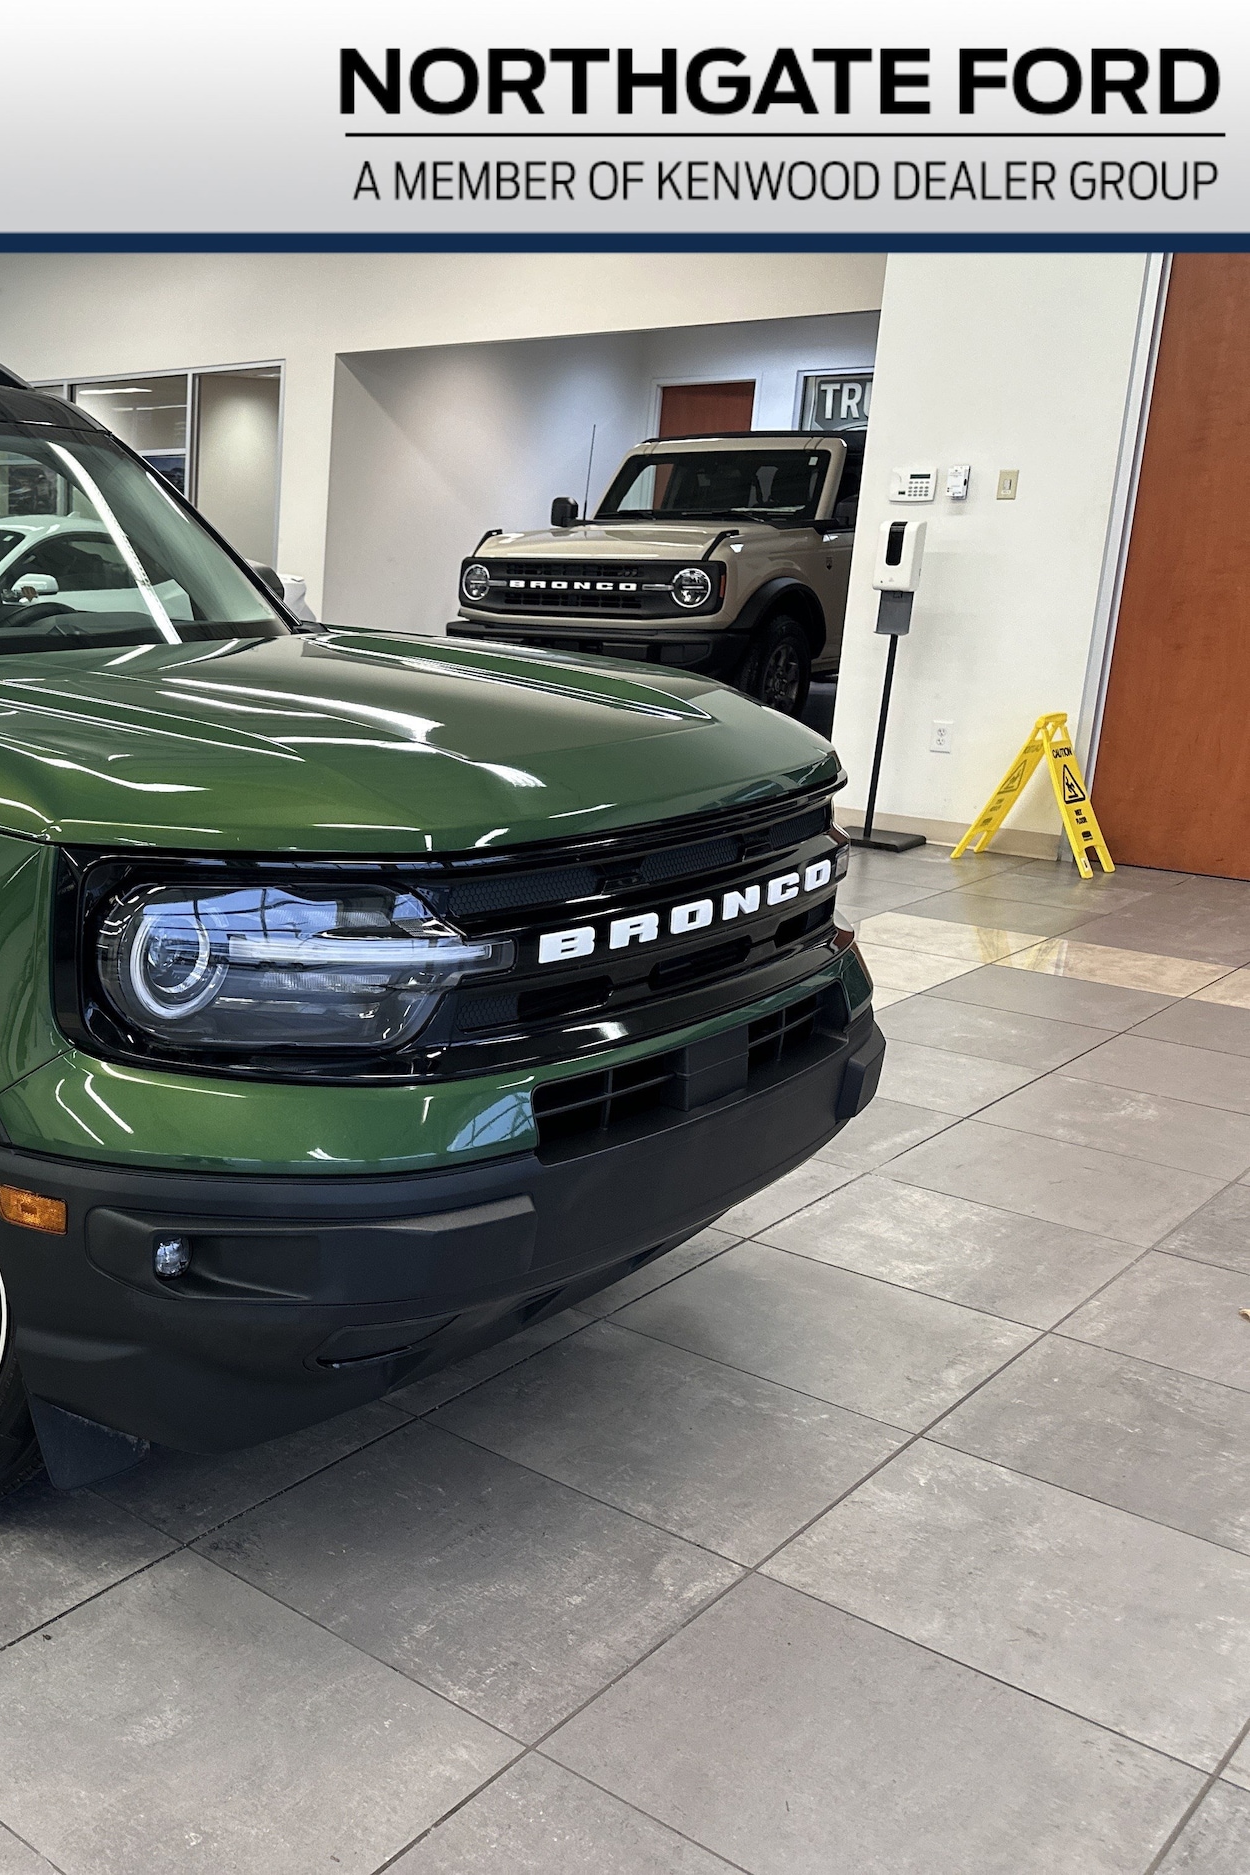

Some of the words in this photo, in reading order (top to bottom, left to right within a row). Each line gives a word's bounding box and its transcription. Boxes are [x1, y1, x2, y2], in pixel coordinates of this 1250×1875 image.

[509, 580, 637, 591] BRONCO
[1052, 747, 1072, 759] CAUTION
[538, 859, 833, 965] BRONCO
